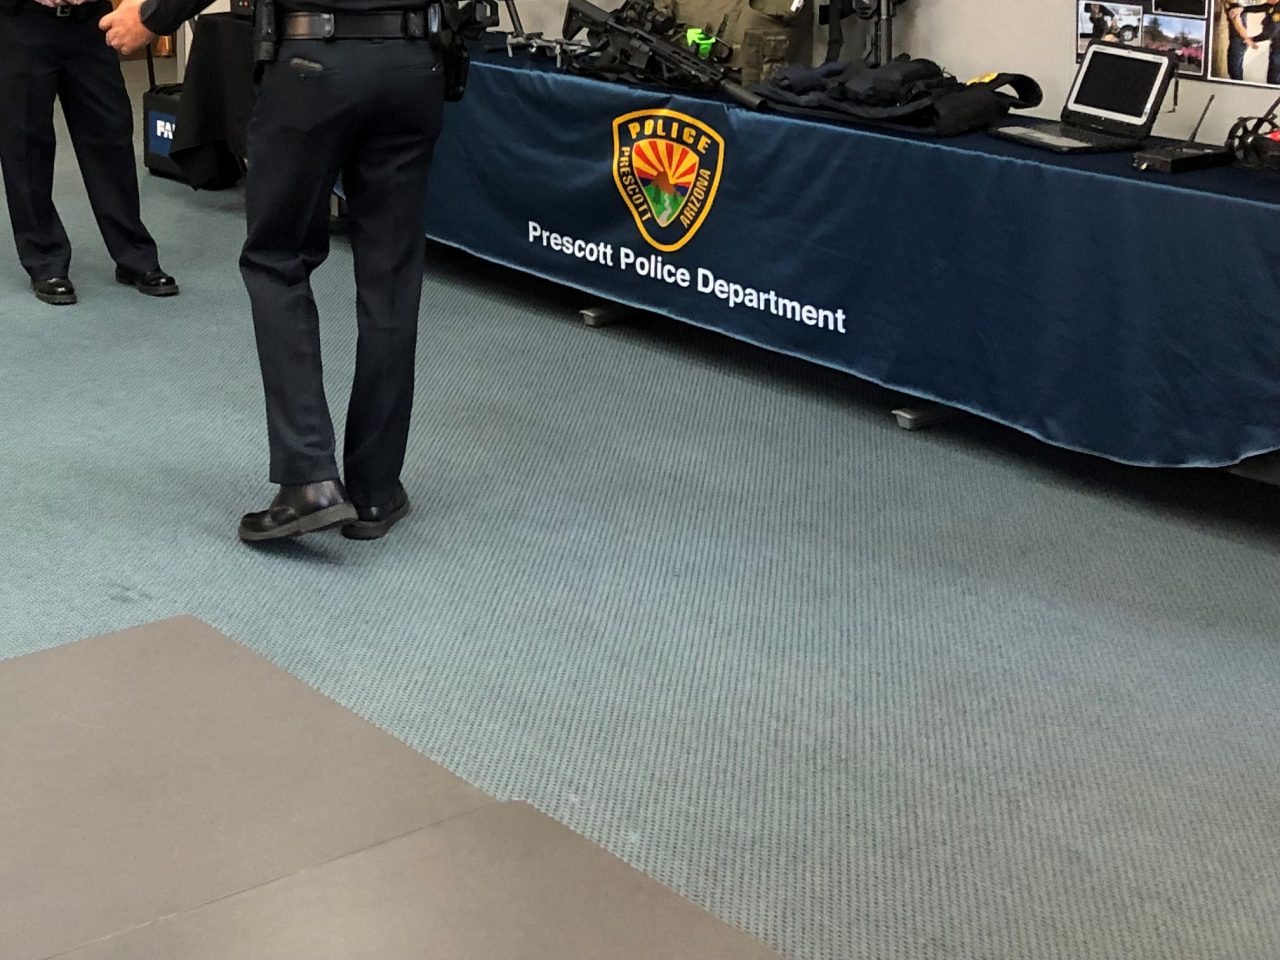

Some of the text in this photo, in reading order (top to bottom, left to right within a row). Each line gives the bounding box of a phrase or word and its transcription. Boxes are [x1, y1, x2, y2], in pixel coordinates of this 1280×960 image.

[628, 118, 712, 155] POLICE
[619, 146, 652, 222] PRESCOTT
[679, 167, 712, 229] ARIZONA
[528, 220, 846, 333] Prescott Police Department
